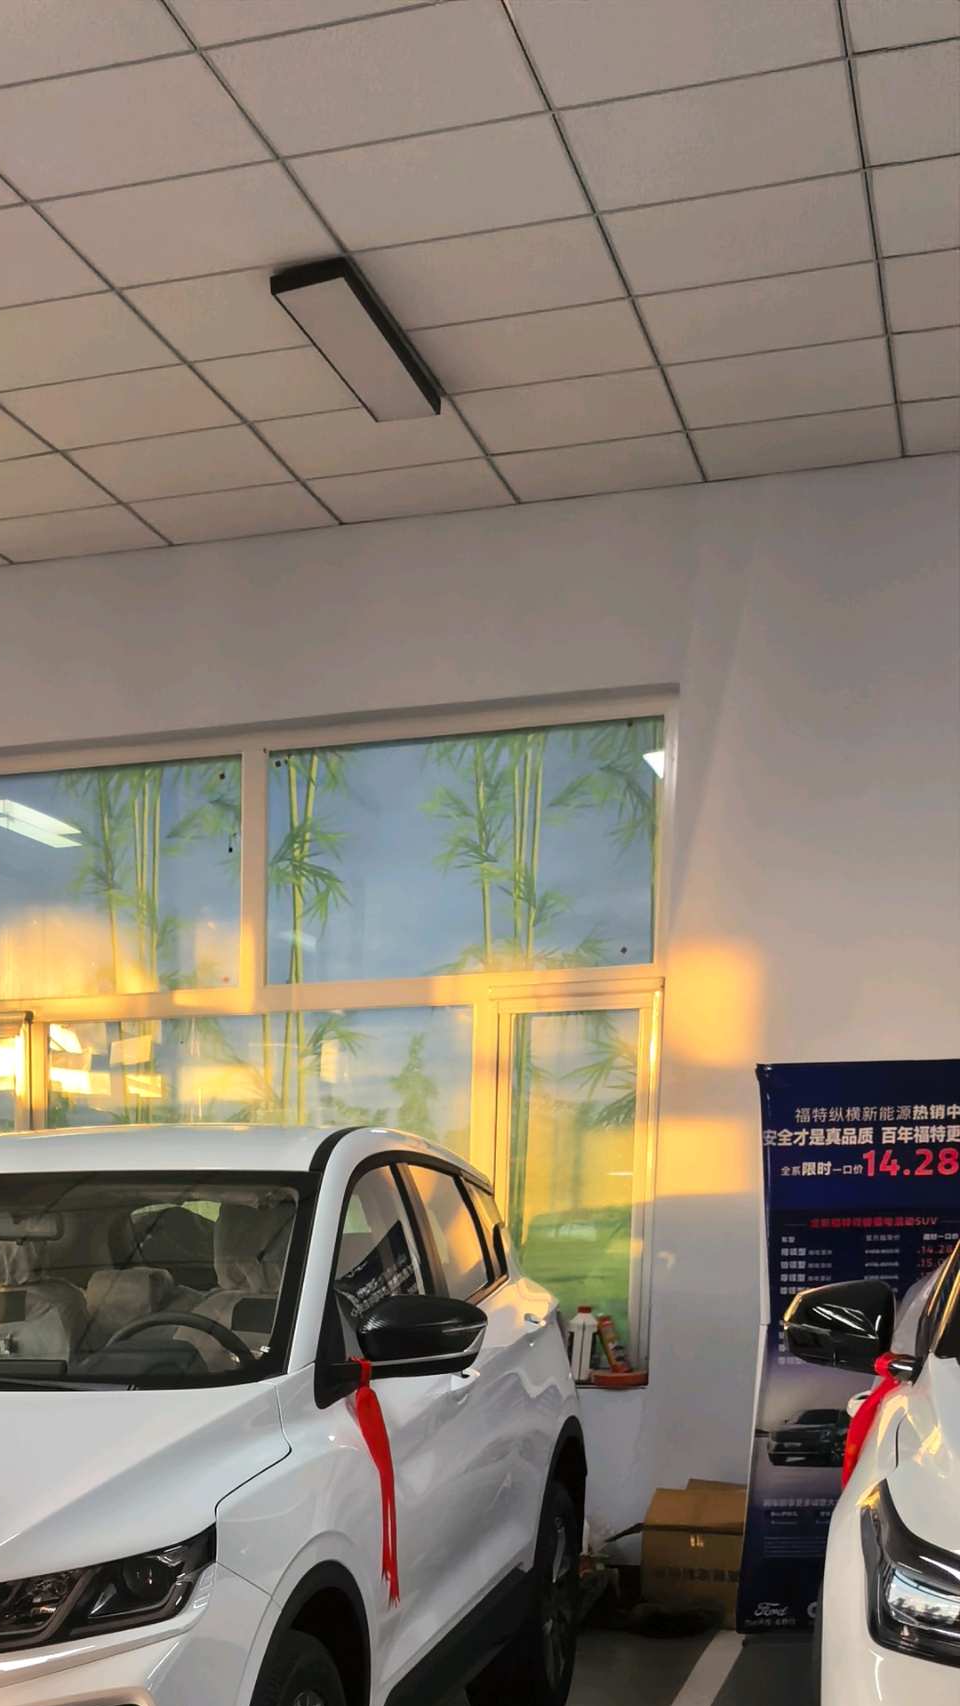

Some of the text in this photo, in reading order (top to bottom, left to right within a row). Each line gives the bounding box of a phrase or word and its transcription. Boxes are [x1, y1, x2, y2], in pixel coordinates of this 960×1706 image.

[795, 1104, 960, 1123] 福特纵横新能源热销中
[764, 1127, 873, 1146] 安全才是真品质
[753, 1601, 790, 1617] Ford
